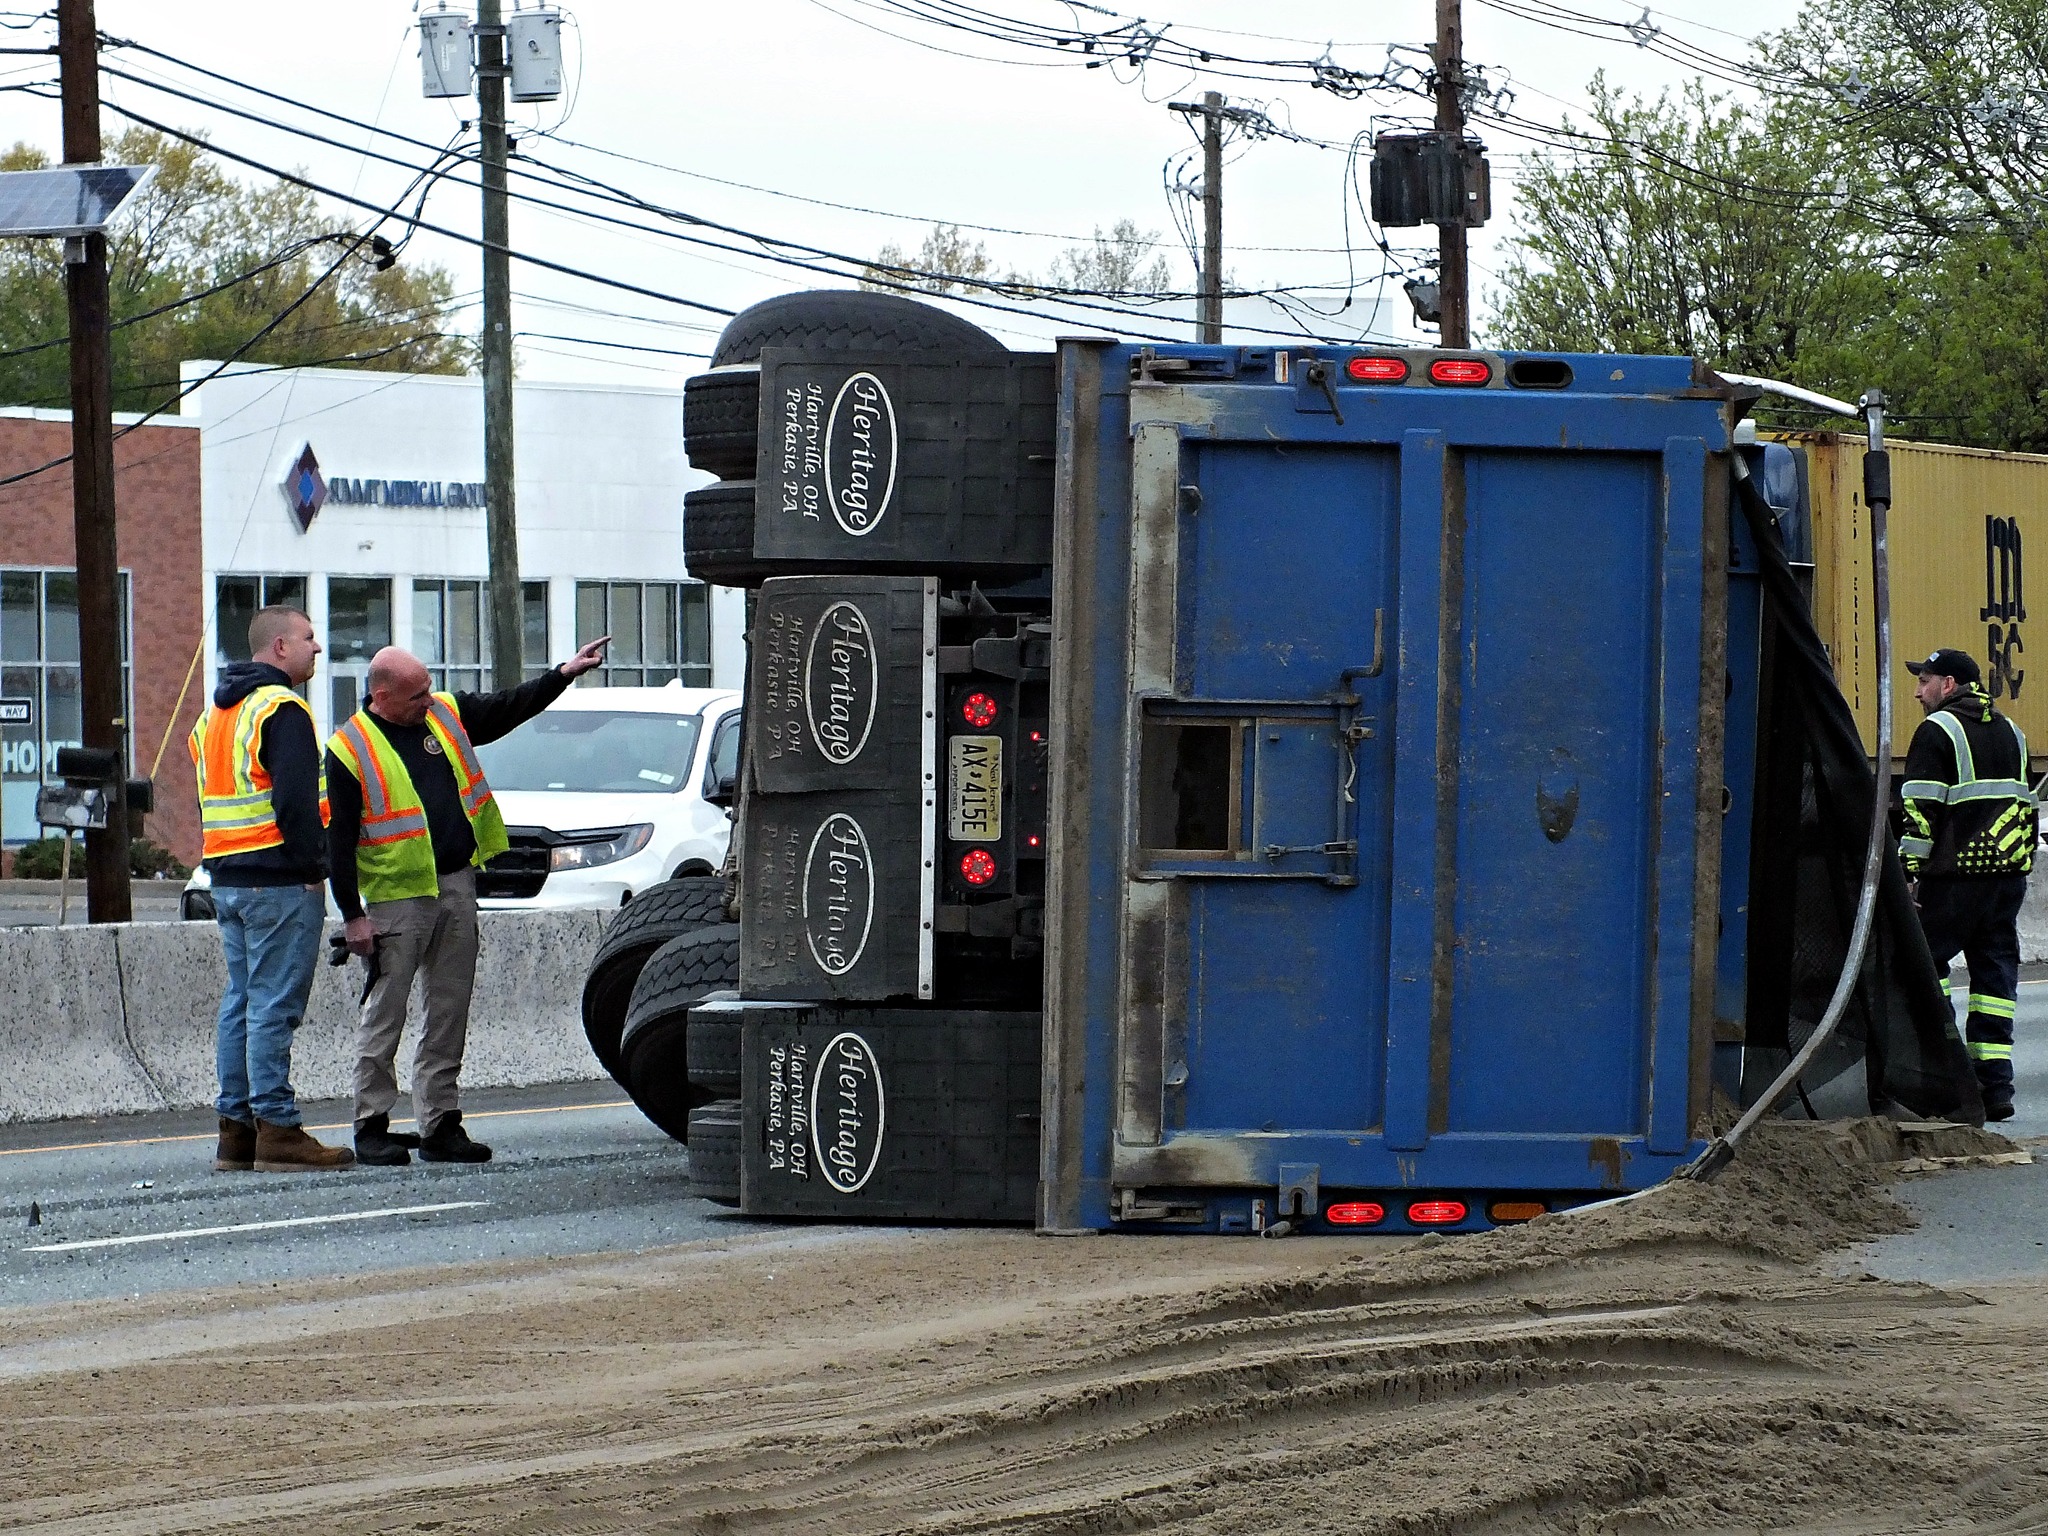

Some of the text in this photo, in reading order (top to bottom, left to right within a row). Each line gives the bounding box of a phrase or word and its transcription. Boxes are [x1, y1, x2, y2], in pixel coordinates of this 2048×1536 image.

[782, 388, 802, 513] Perkasie, PA
[802, 383, 823, 522] Hartville, OH
[841, 382, 881, 526] Heritage
[5, 707, 24, 717] WAY
[766, 612, 786, 760] Perkasie, PA
[786, 614, 804, 756] Hartville, OH
[820, 611, 867, 757] Heritage
[962, 744, 988, 832] AX 415E
[988, 763, 999, 813] New Jersey
[818, 823, 864, 968] Heritage
[768, 1047, 788, 1170] Perkasie, PA
[788, 1042, 808, 1178] Hartville, OH
[829, 1041, 867, 1183] Heritage
